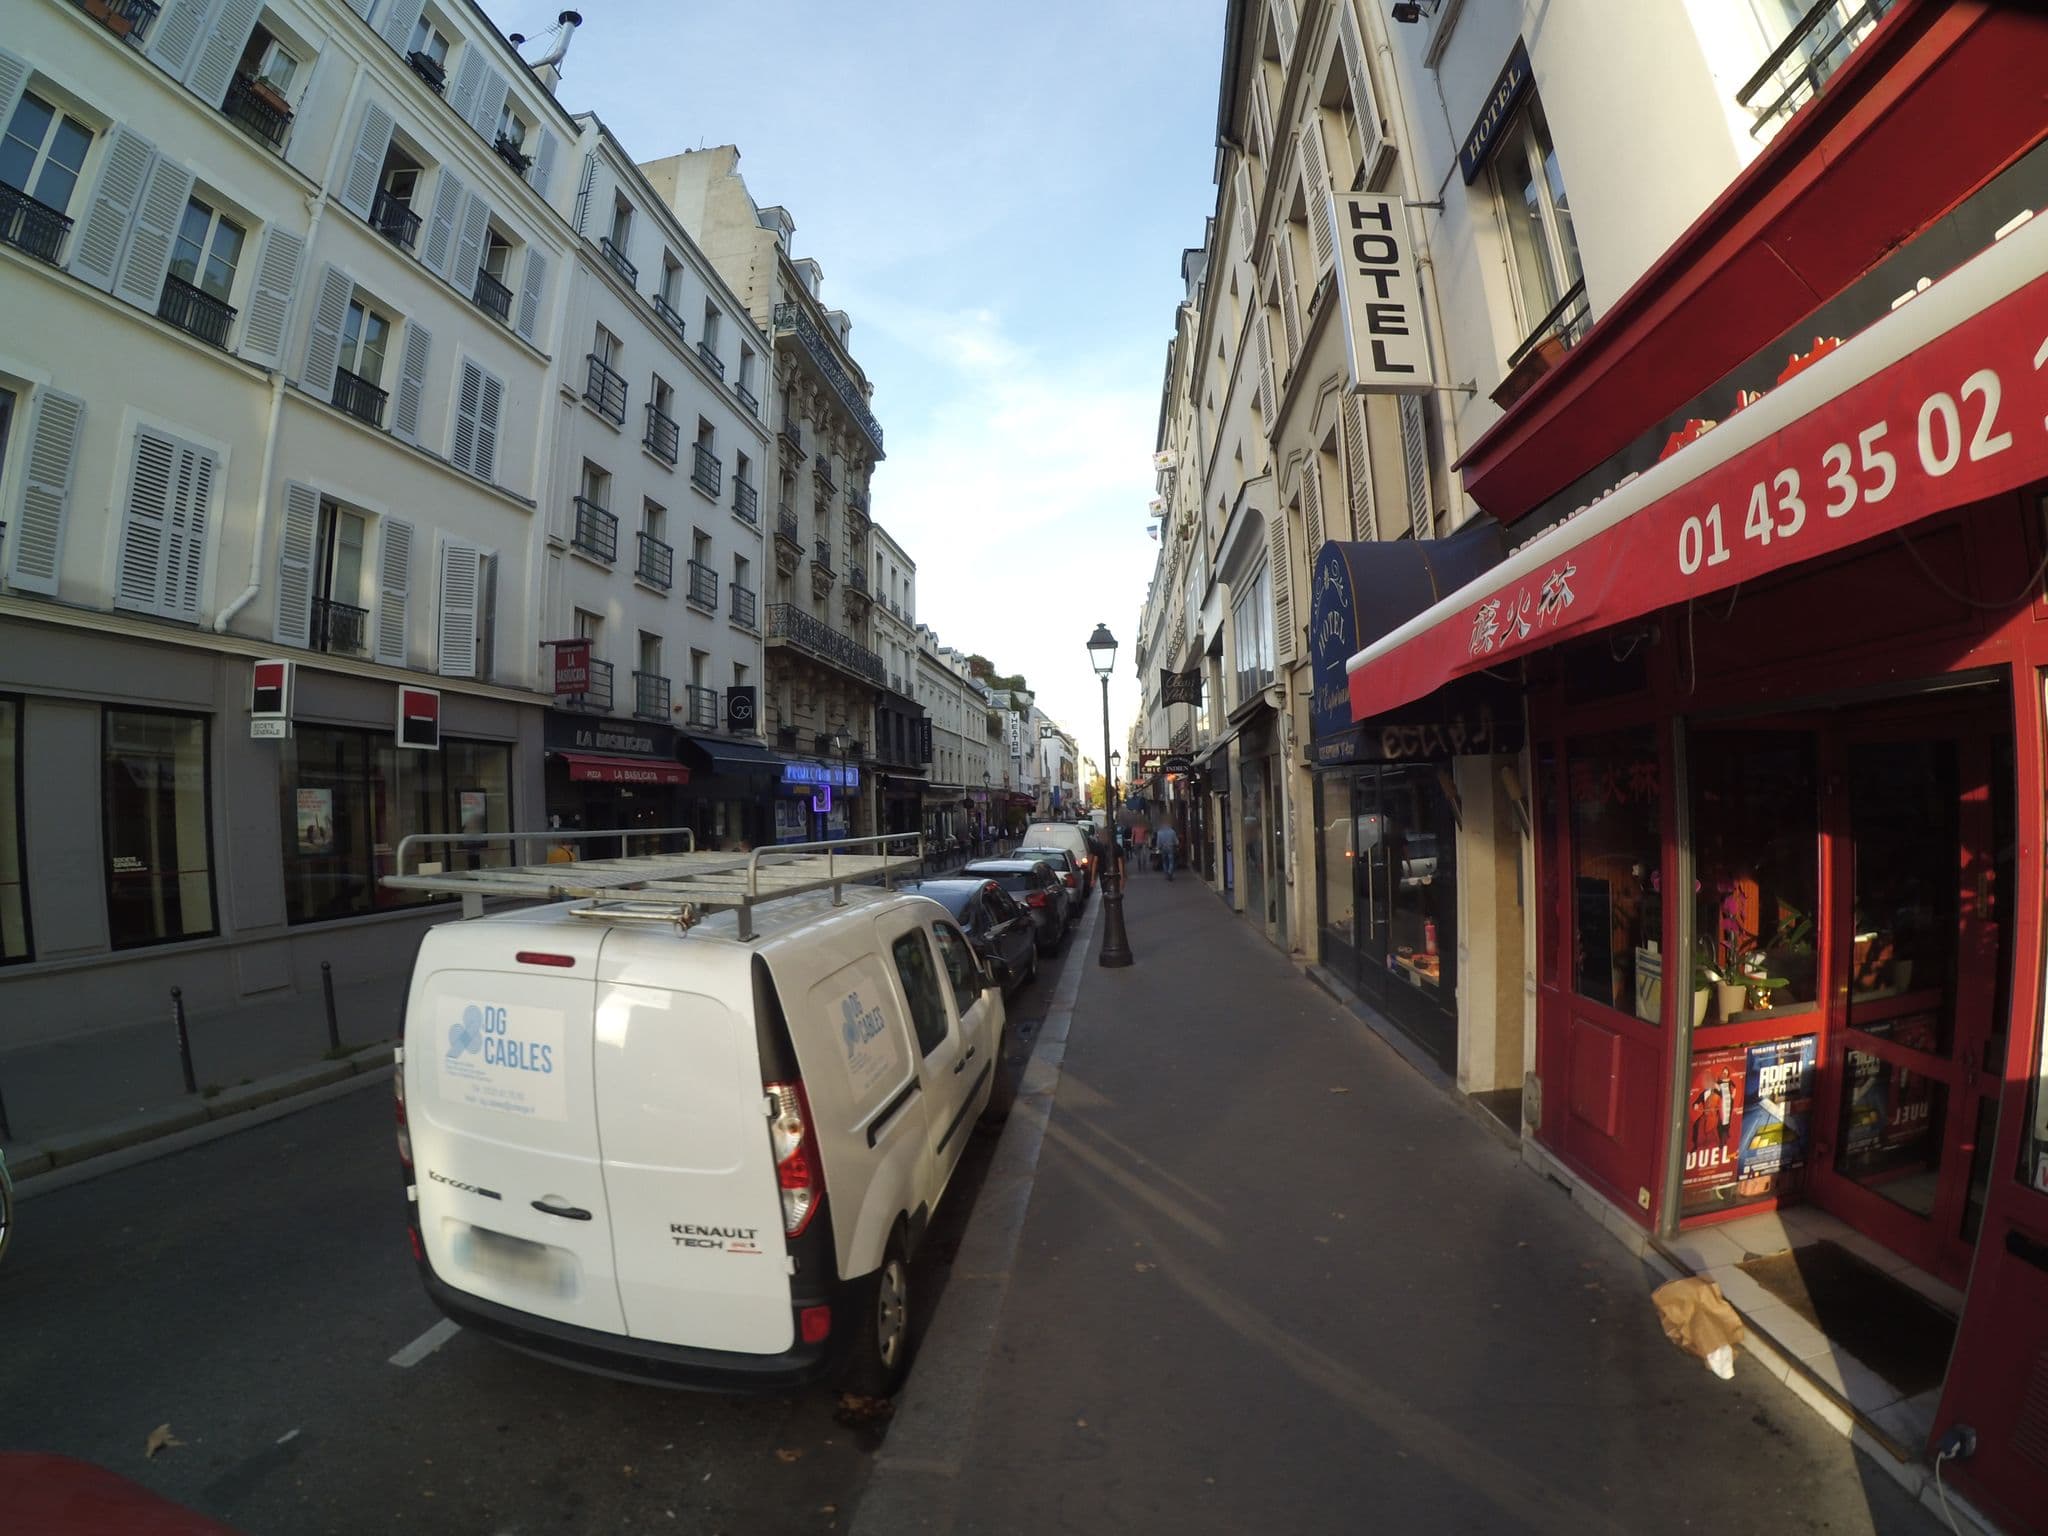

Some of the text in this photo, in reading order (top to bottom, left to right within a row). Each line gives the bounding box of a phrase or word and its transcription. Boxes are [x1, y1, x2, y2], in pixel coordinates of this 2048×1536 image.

[1469, 66, 1521, 164] HOTEL
[1348, 201, 1415, 373] HOTEL
[1679, 503, 1730, 575] 01
[1744, 468, 1806, 546] 43
[1822, 420, 1897, 518] 35
[1917, 369, 2013, 477] 02
[1318, 610, 1346, 657] HOTEL
[567, 653, 576, 668] LA
[576, 729, 593, 747] LA
[613, 770, 622, 779] LA
[624, 770, 658, 781] BASILICATA
[484, 1005, 507, 1036] DG
[484, 1036, 553, 1074] CABLES
[1685, 1145, 1731, 1171] DUEL
[670, 1223, 759, 1239] RENAULT
[672, 1236, 723, 1249] TECH
